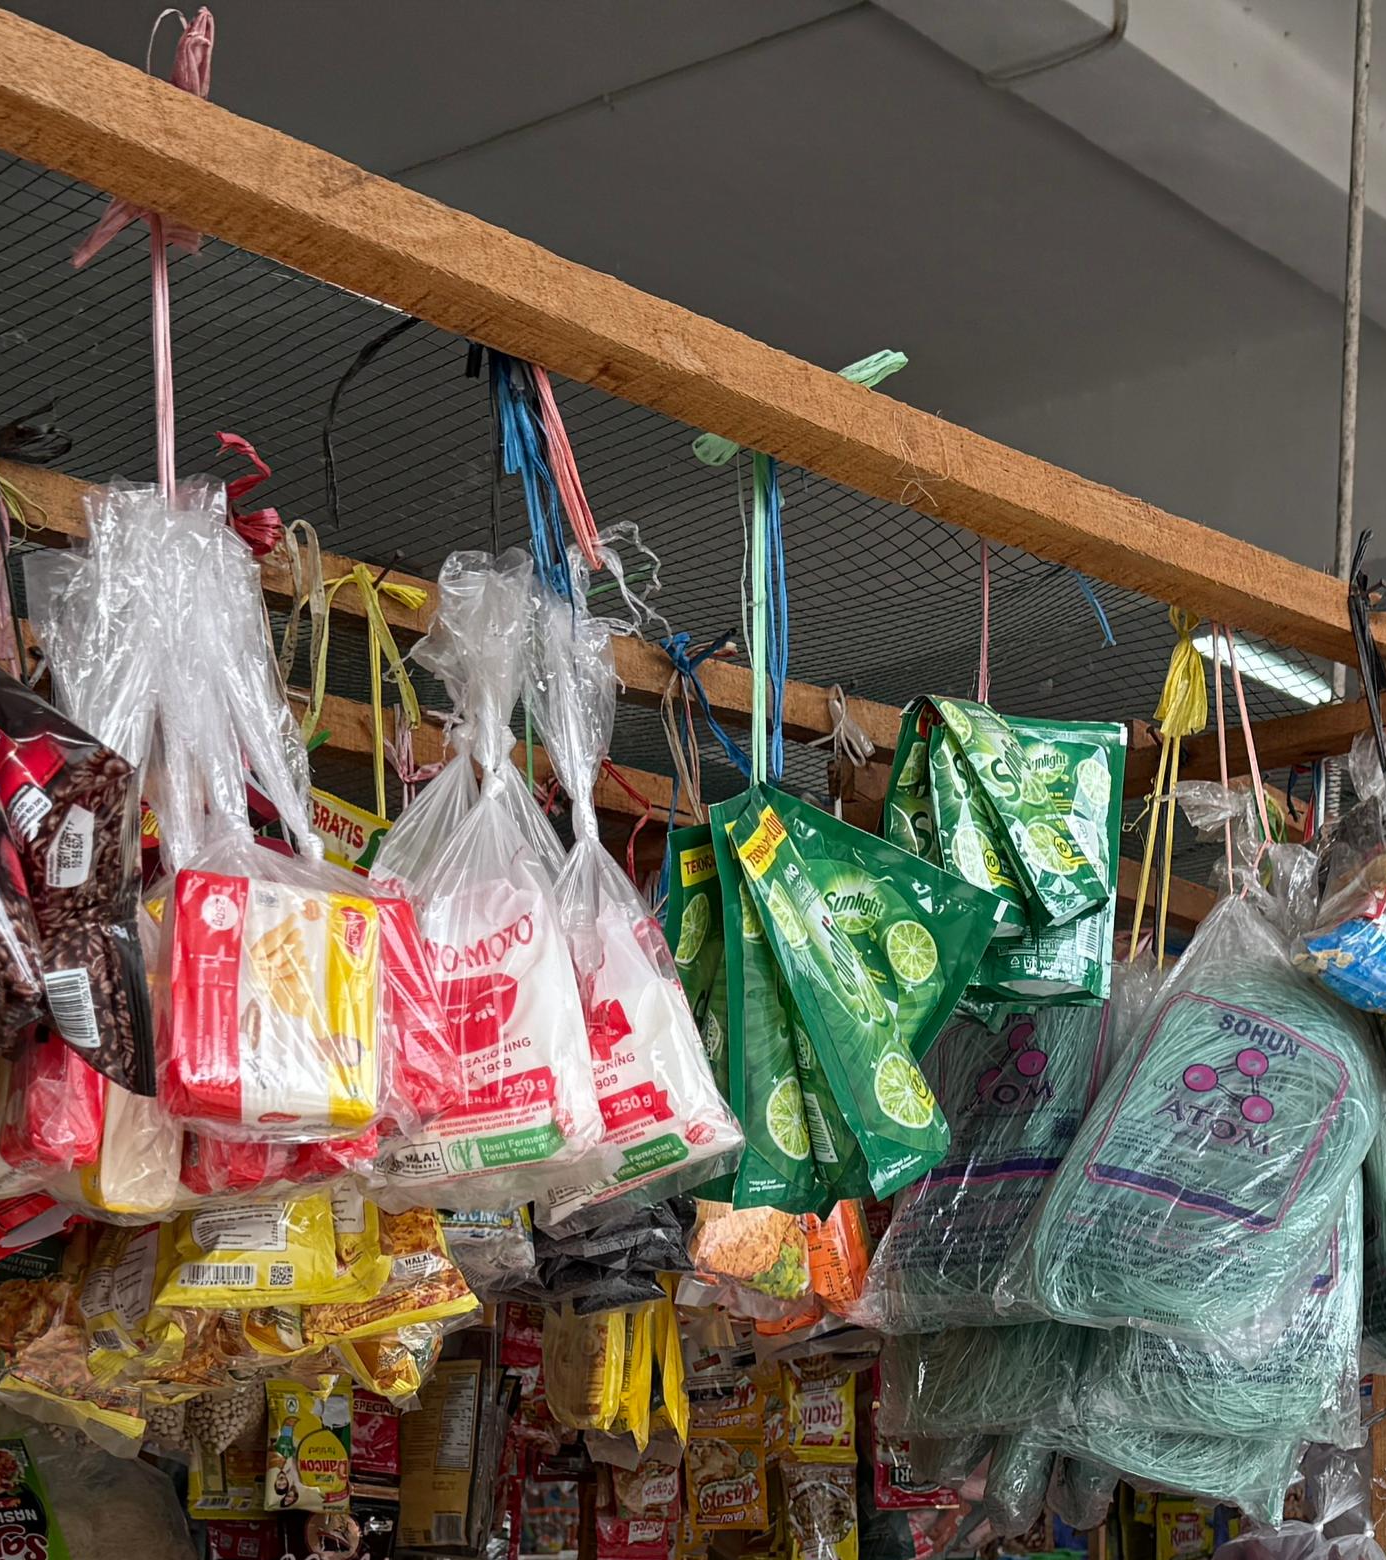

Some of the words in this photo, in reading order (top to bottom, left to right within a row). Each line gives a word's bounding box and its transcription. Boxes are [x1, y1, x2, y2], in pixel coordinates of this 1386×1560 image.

[823, 891, 885, 918] Sunlight
[1217, 1013, 1302, 1060] SOHUN
[613, 1095, 641, 1117] 250
[1156, 1100, 1270, 1155] ATOM
[352, 1398, 396, 1413] SPECIAL
[801, 1400, 843, 1430] Racik
[8, 1507, 38, 1523] NASI
